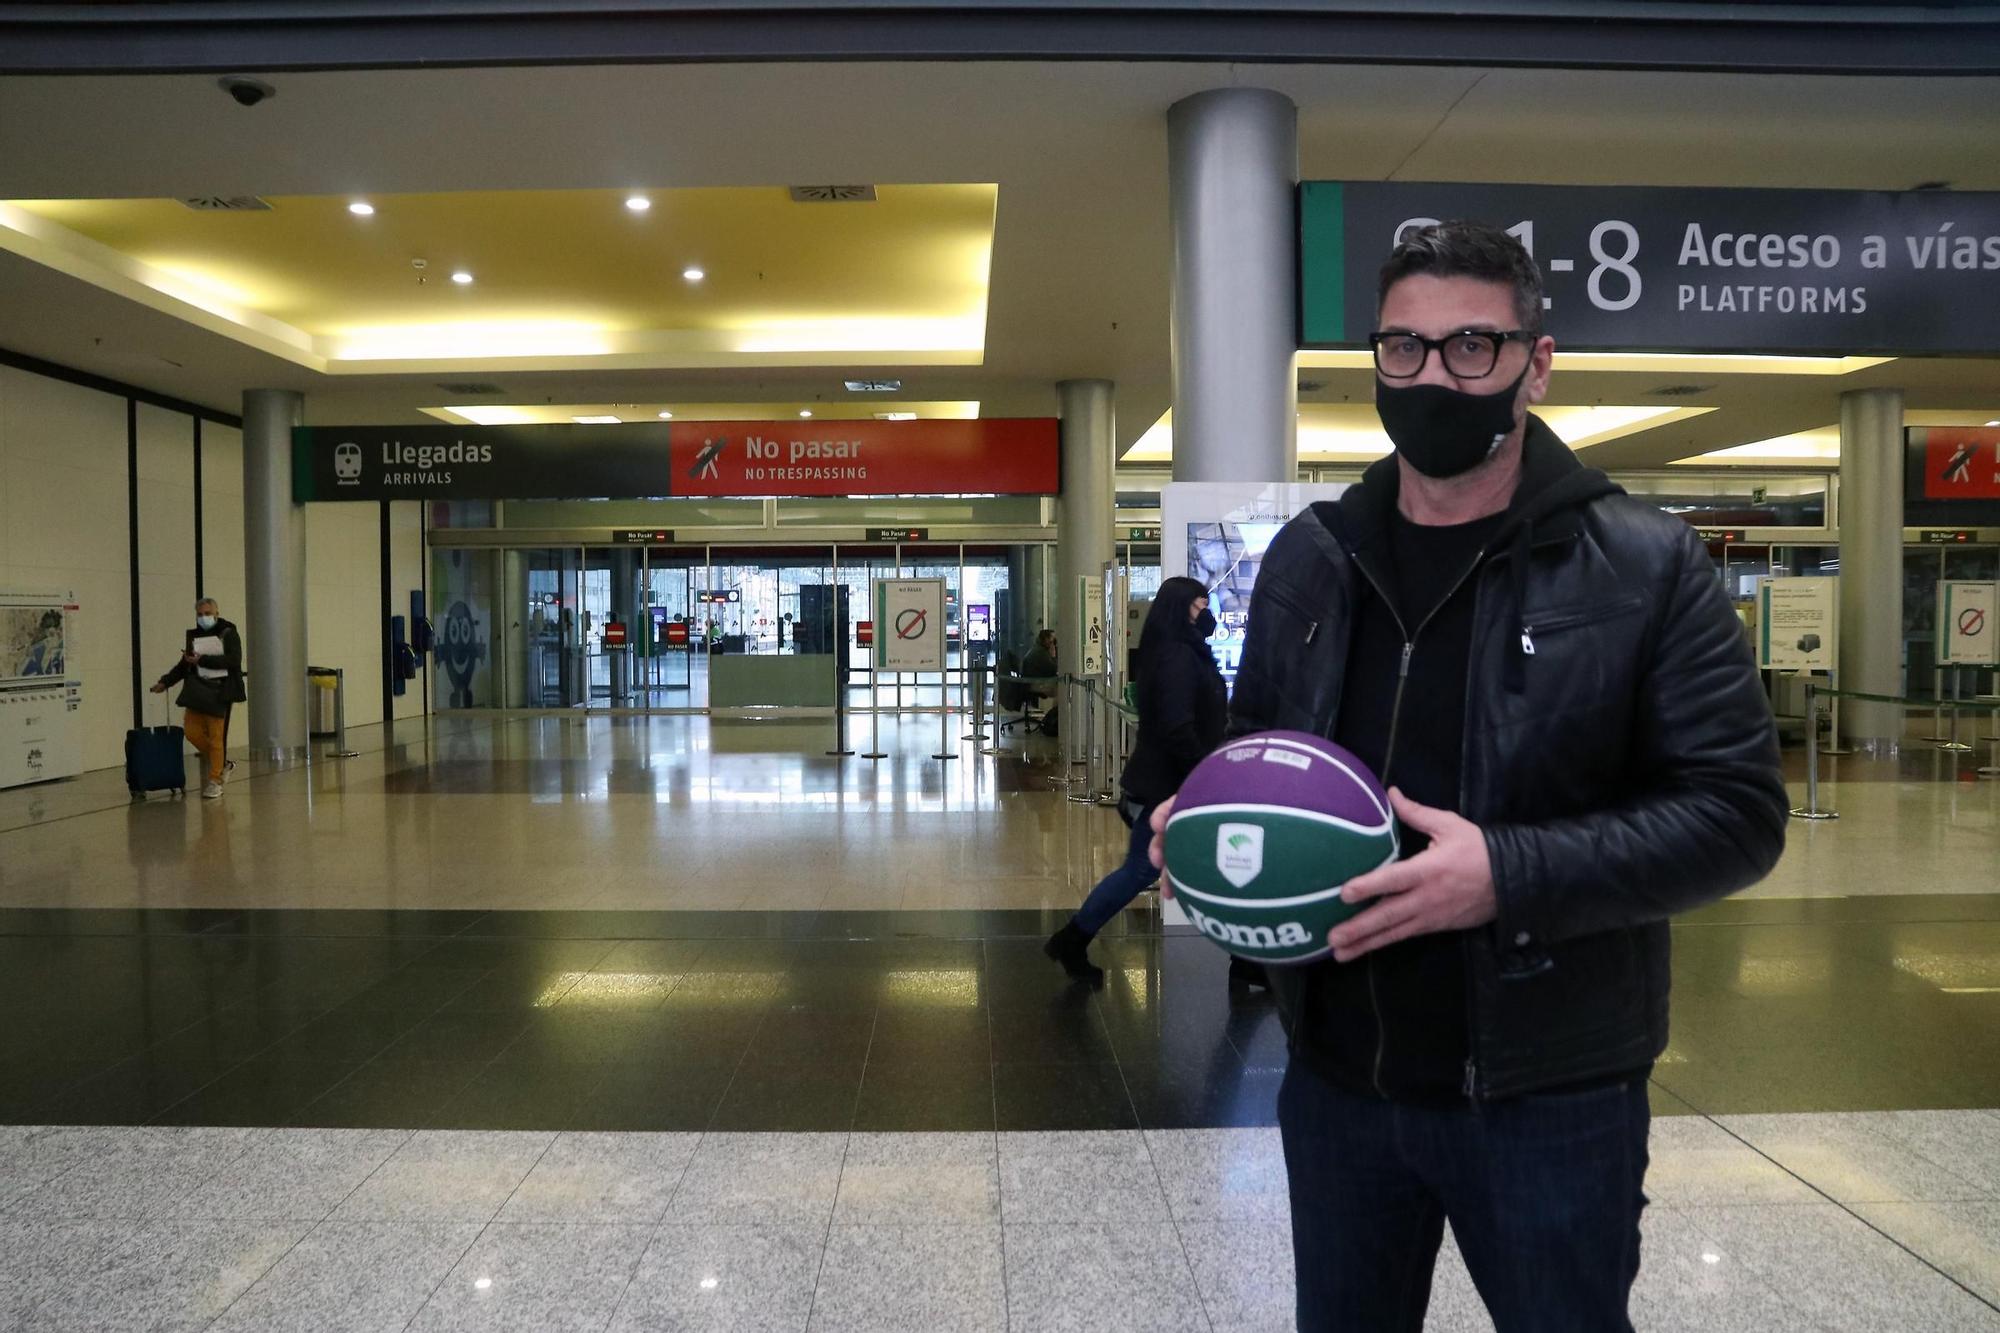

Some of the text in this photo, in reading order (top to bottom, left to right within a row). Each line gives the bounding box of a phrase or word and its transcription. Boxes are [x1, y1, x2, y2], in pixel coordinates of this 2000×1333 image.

[1677, 221, 2000, 270] Acceso a vías
[1678, 284, 1867, 314] PLATFORMS
[382, 440, 493, 469] Llegadas
[746, 436, 862, 464] No pasar
[383, 472, 452, 485] ARRIVALS
[745, 466, 867, 480] NO TRESPASSING
